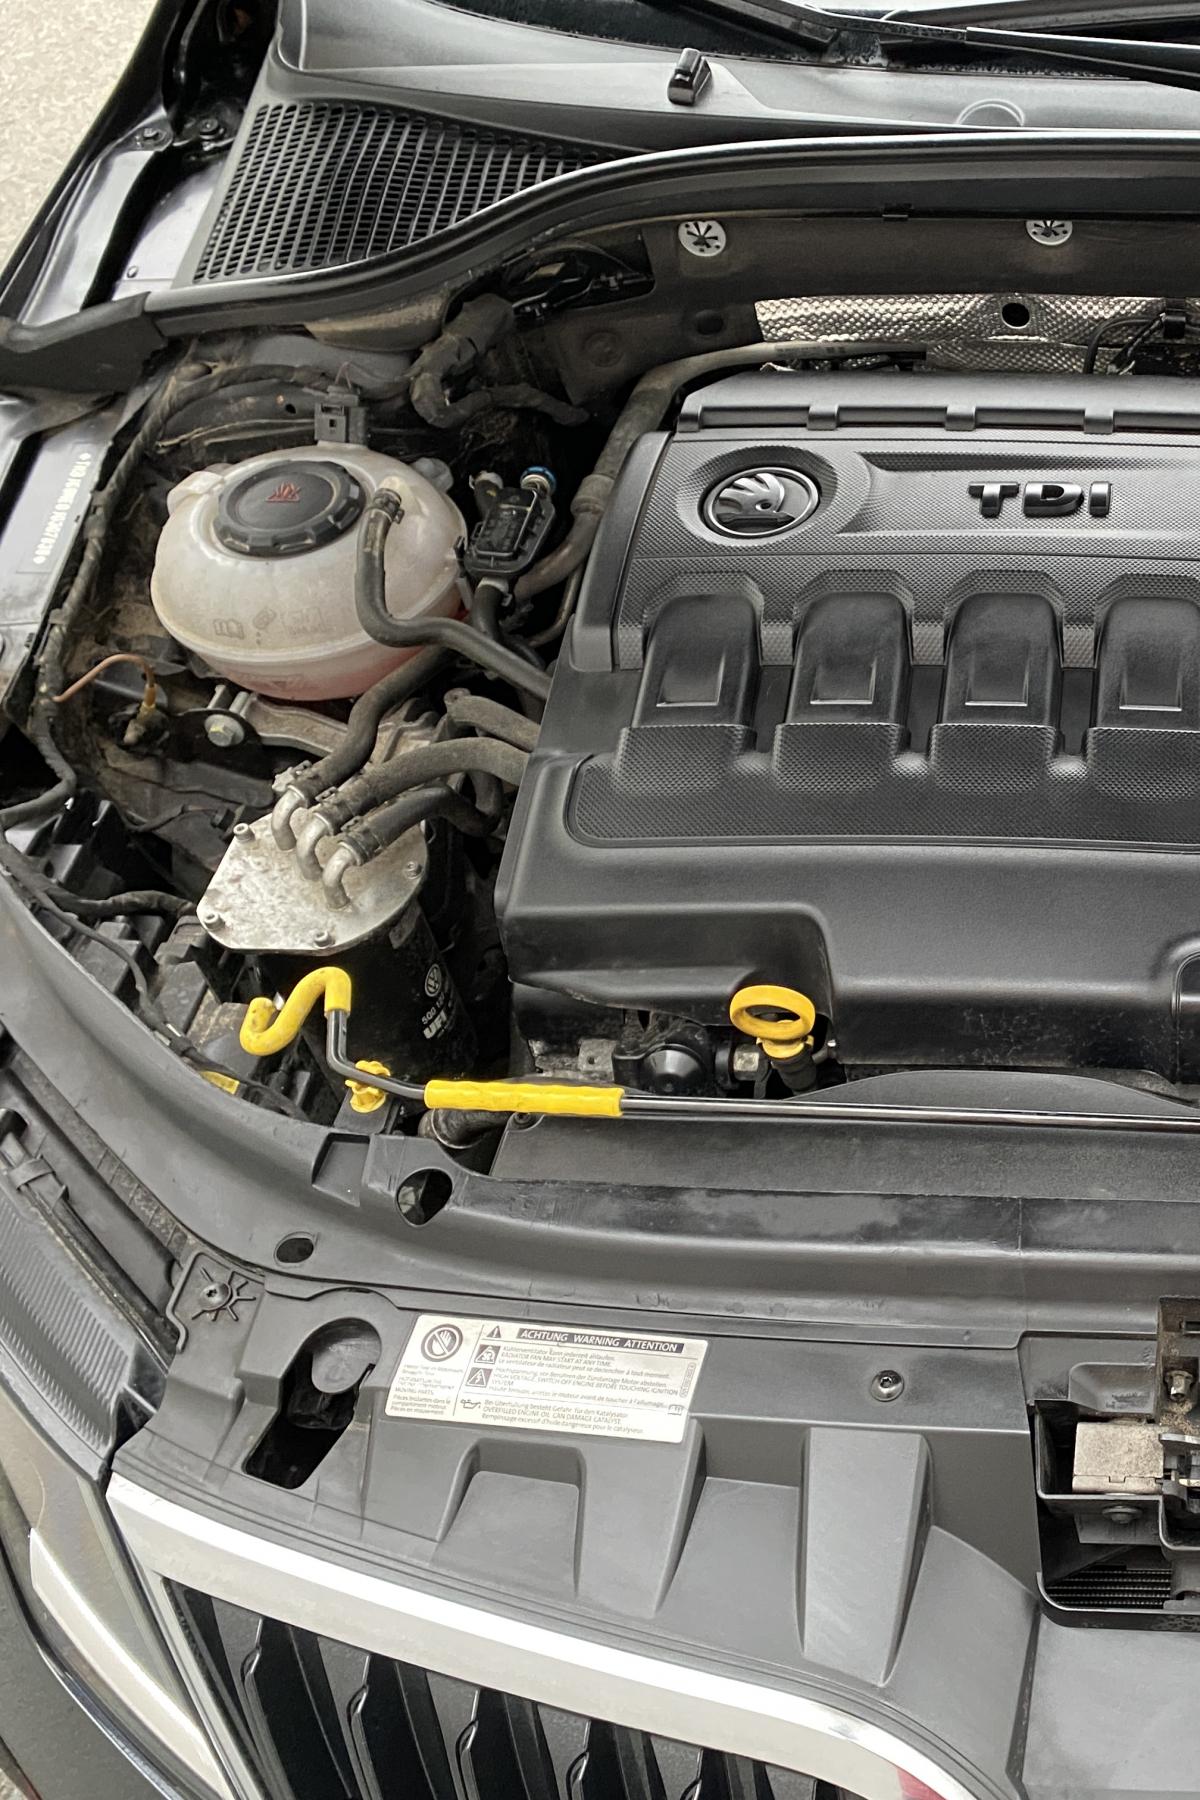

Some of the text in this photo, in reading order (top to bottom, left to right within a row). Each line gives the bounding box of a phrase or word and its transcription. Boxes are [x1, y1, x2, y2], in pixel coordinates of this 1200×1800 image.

[968, 481, 1112, 518] TDI
[520, 1329, 677, 1352] ACHTUNG WARNING ATTENTION
